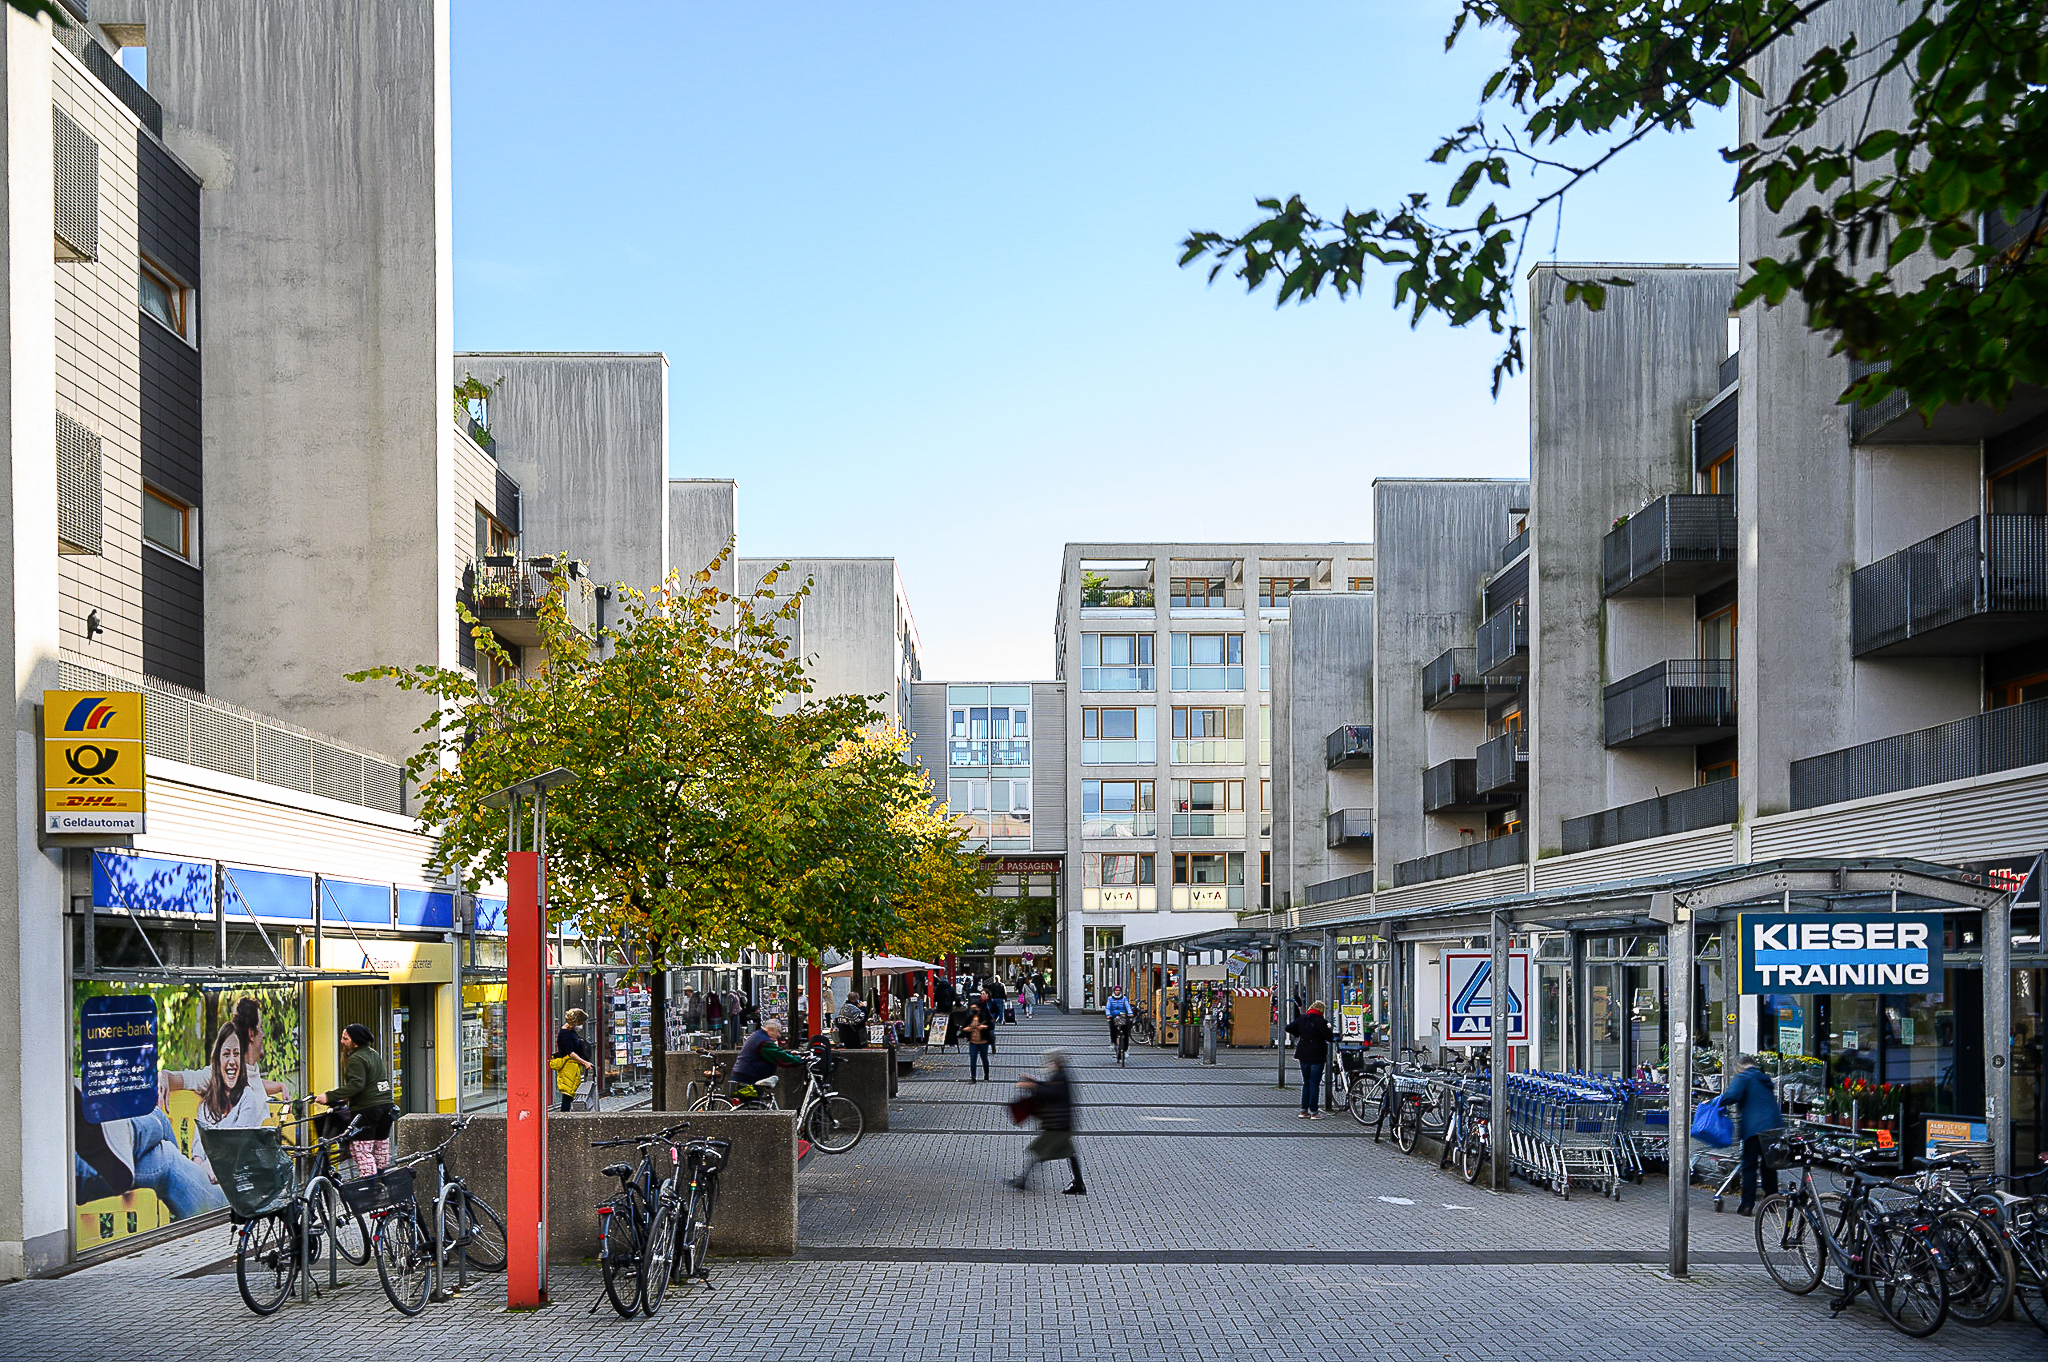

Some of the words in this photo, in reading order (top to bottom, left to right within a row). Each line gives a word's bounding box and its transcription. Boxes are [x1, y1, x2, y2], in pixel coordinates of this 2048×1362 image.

[66, 796, 117, 806] DHL
[62, 817, 135, 828] Geldautomat
[1007, 862, 1053, 870] PASSAGEN
[1754, 923, 1929, 950] KIESER
[1754, 963, 1929, 986] TRAINING
[87, 1020, 153, 1039] unsere-bank
[1459, 1017, 1514, 1032] ALI
